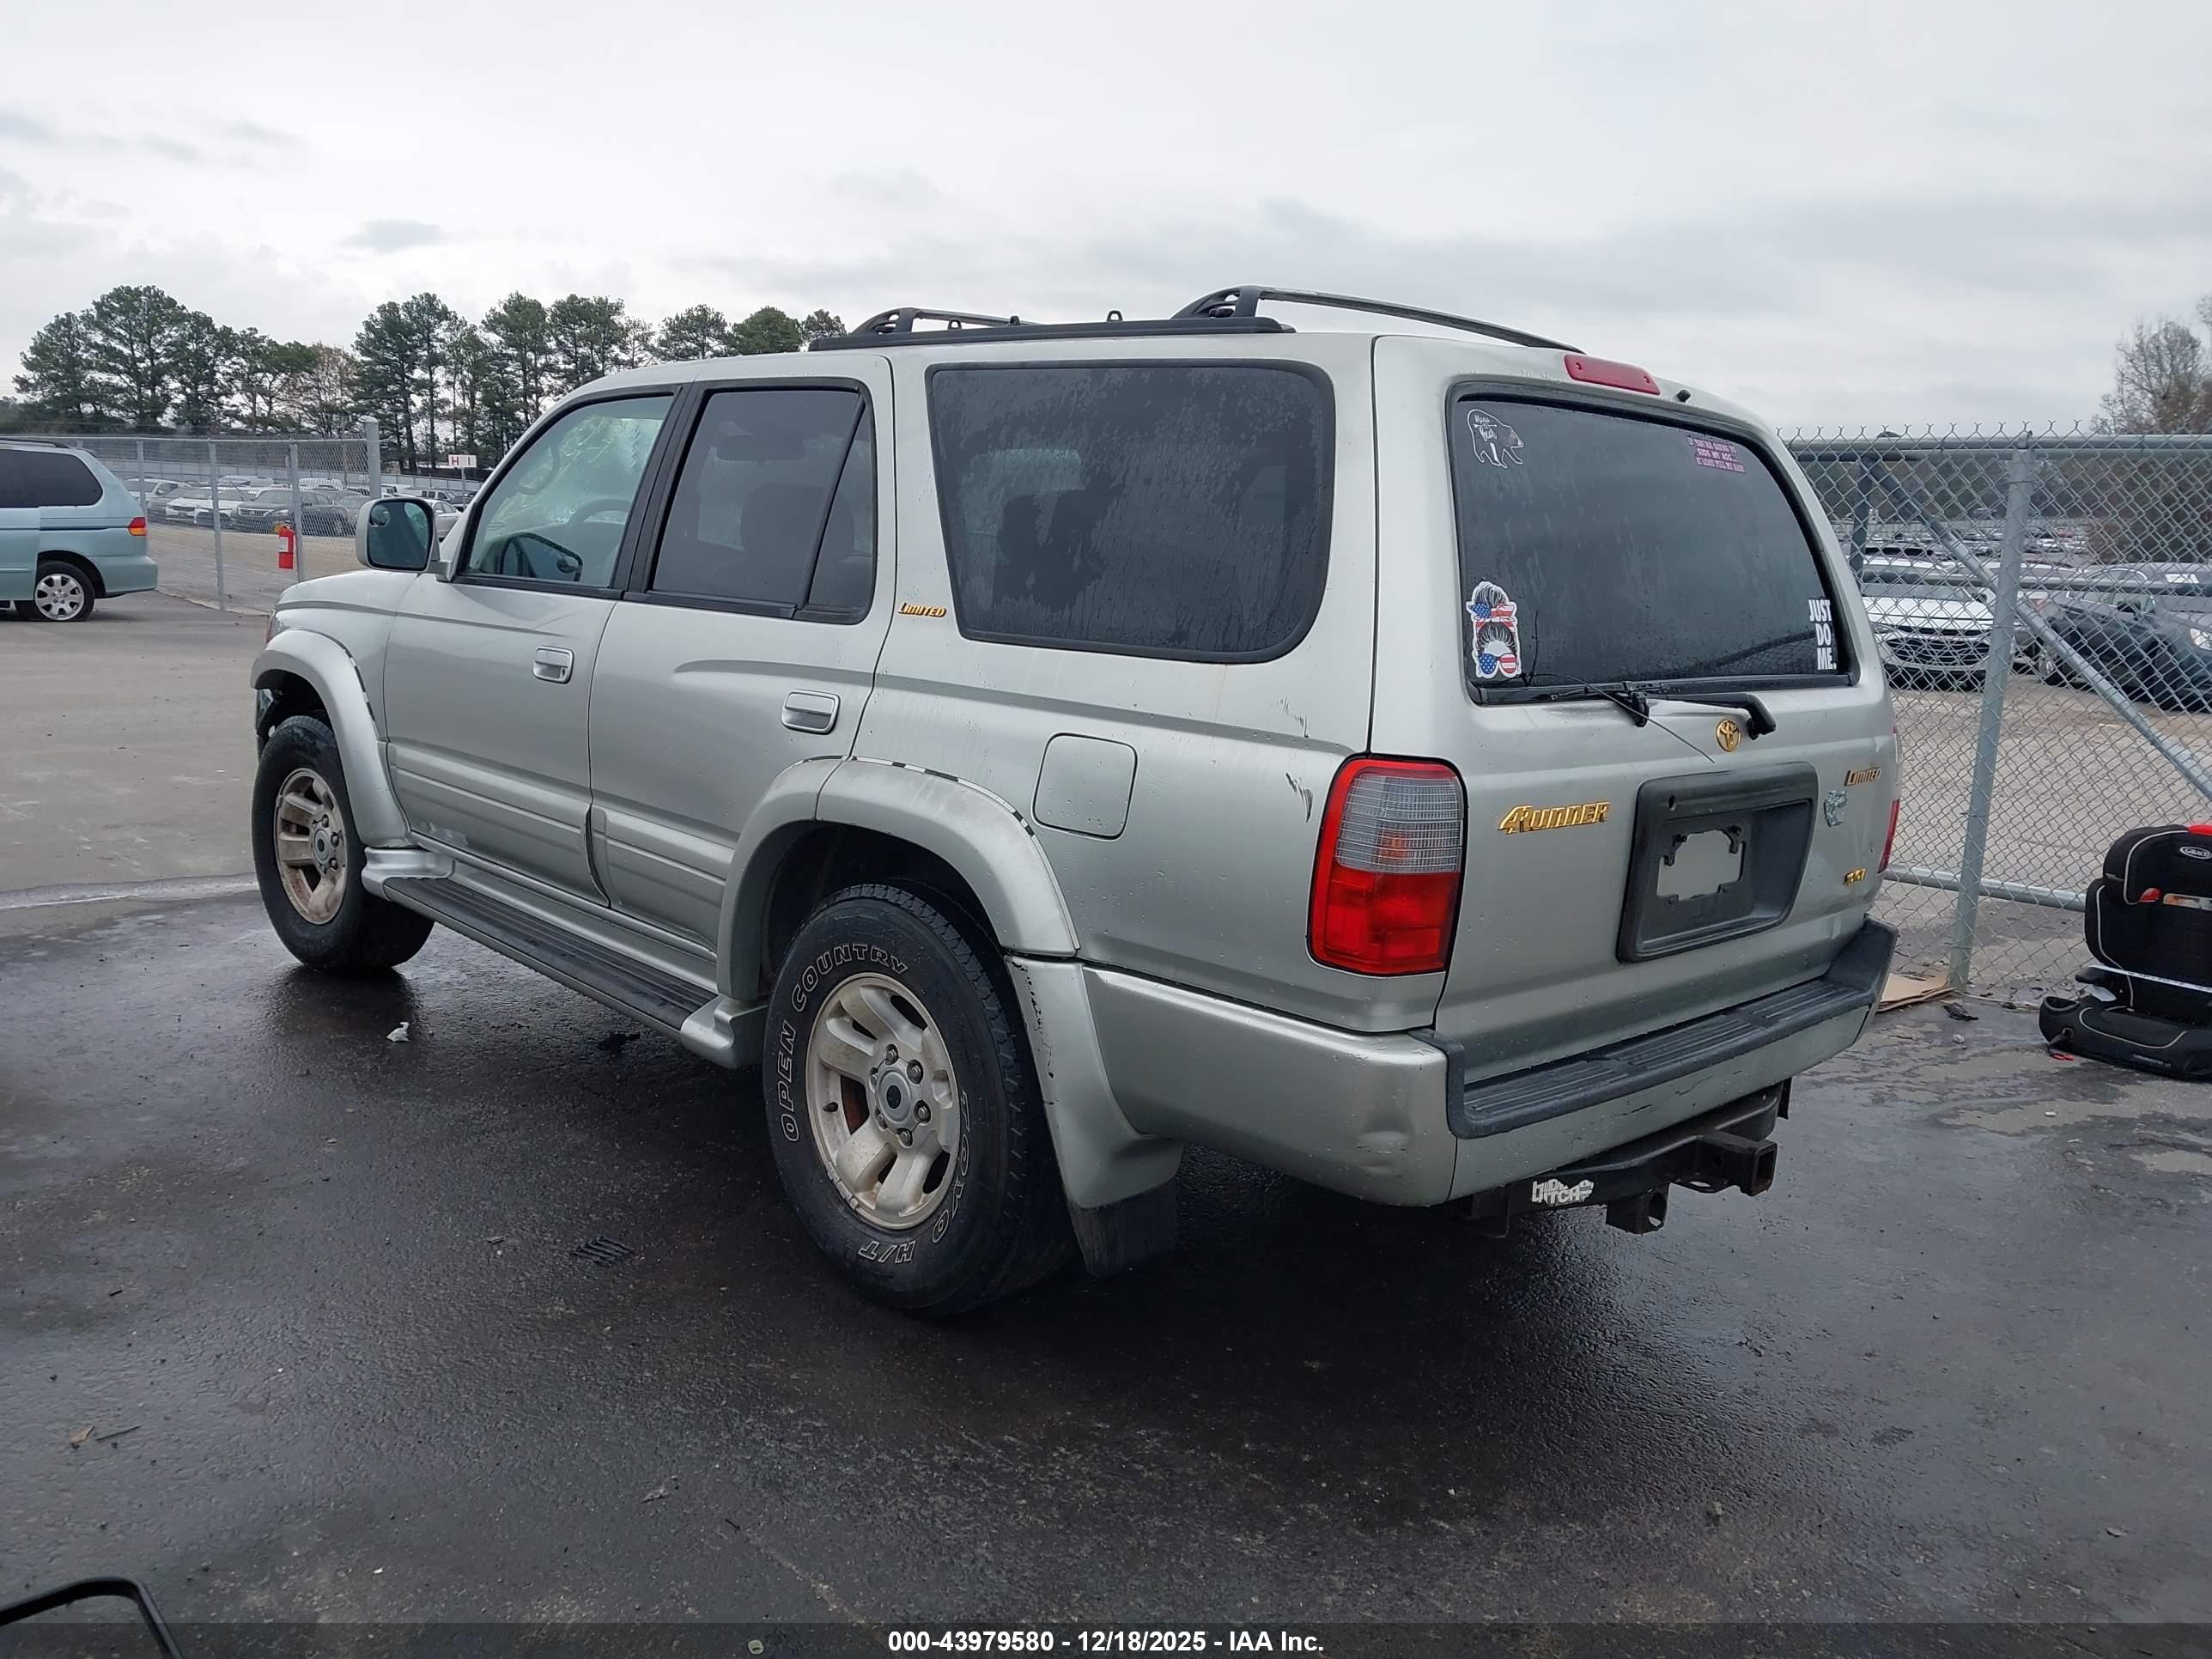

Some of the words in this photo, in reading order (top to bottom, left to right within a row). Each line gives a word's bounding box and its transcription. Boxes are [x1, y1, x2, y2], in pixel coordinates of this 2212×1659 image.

[898, 602, 947, 617] LIMITED
[1808, 599, 1832, 622] JUST
[1815, 623, 1832, 646] DO
[1817, 647, 1838, 670] ME.
[1844, 768, 1882, 787] LIMITED
[777, 1020, 799, 1142] OPEN
[791, 945, 908, 1012] COUNTRY
[932, 1090, 970, 1243] TOYO
[858, 1240, 916, 1263] H/T
